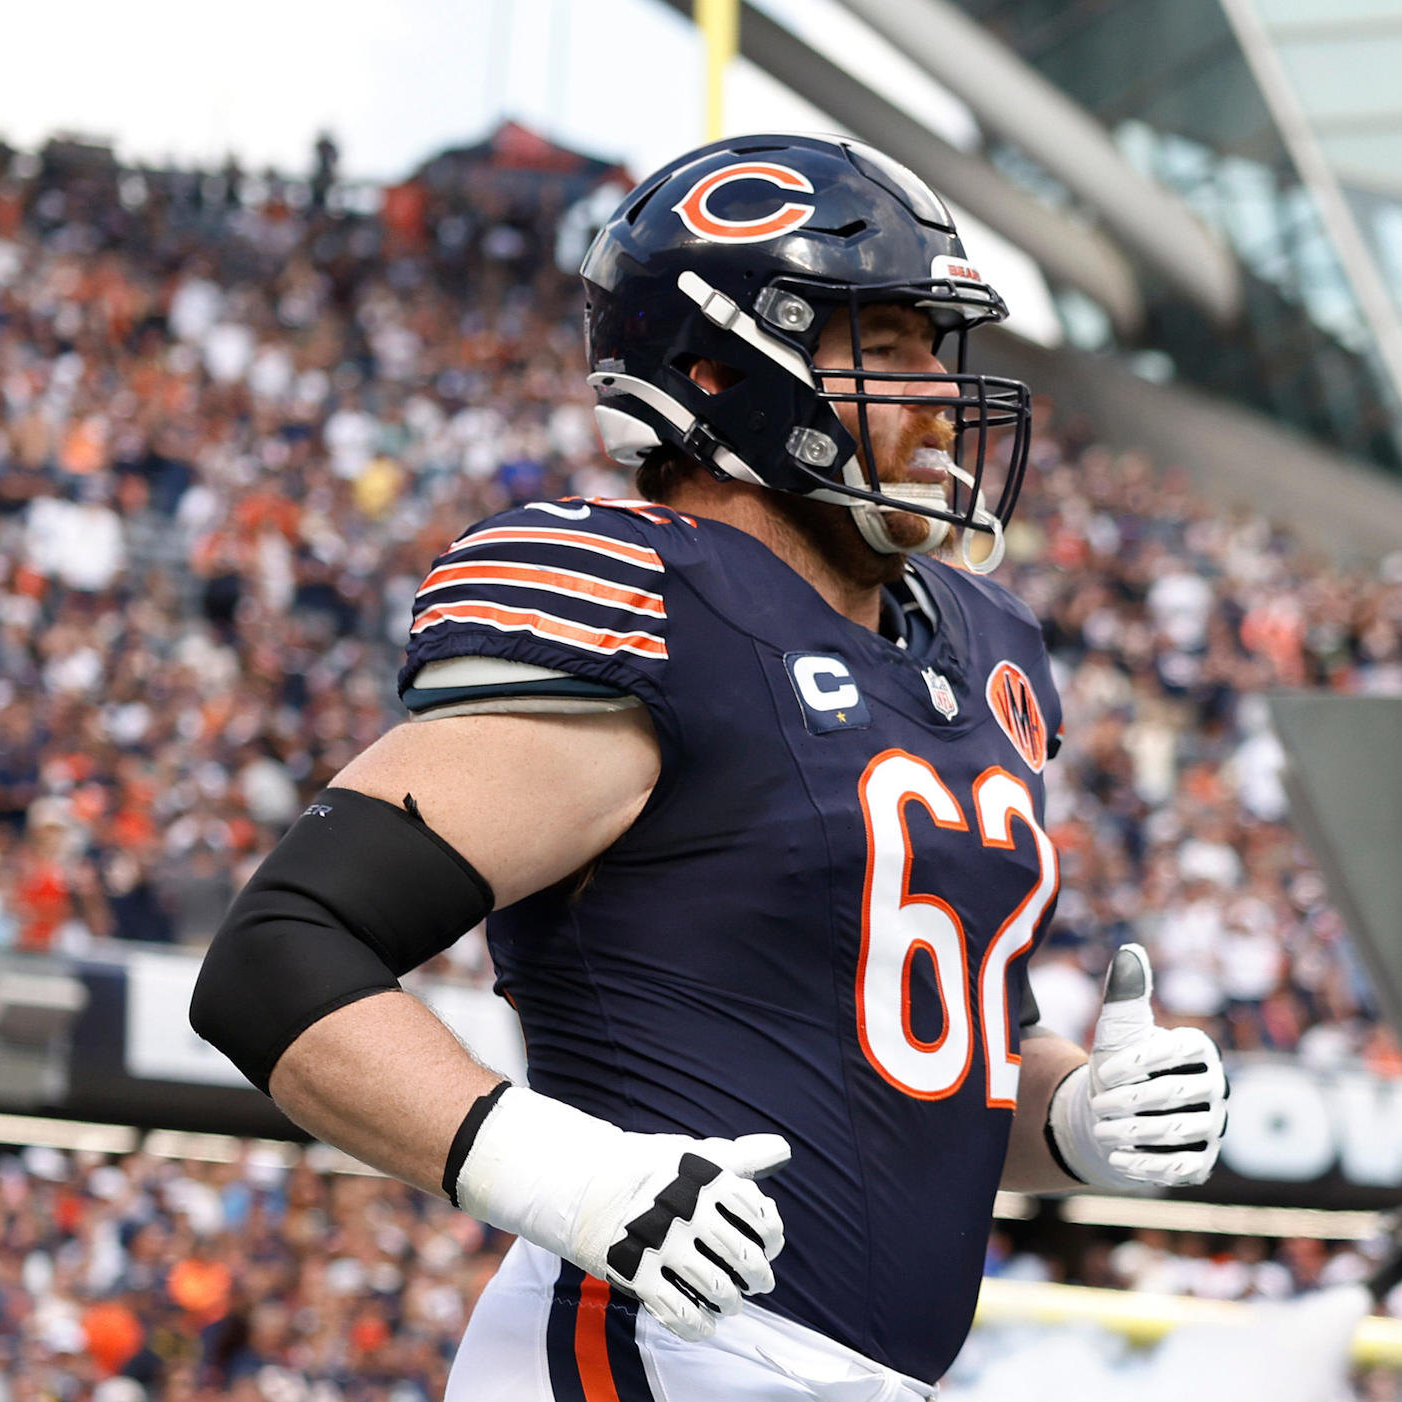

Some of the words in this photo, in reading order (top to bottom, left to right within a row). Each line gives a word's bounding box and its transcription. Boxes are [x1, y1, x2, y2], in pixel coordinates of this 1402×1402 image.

[672, 161, 815, 244] C
[793, 656, 859, 712] C
[855, 747, 1061, 1111] 62
